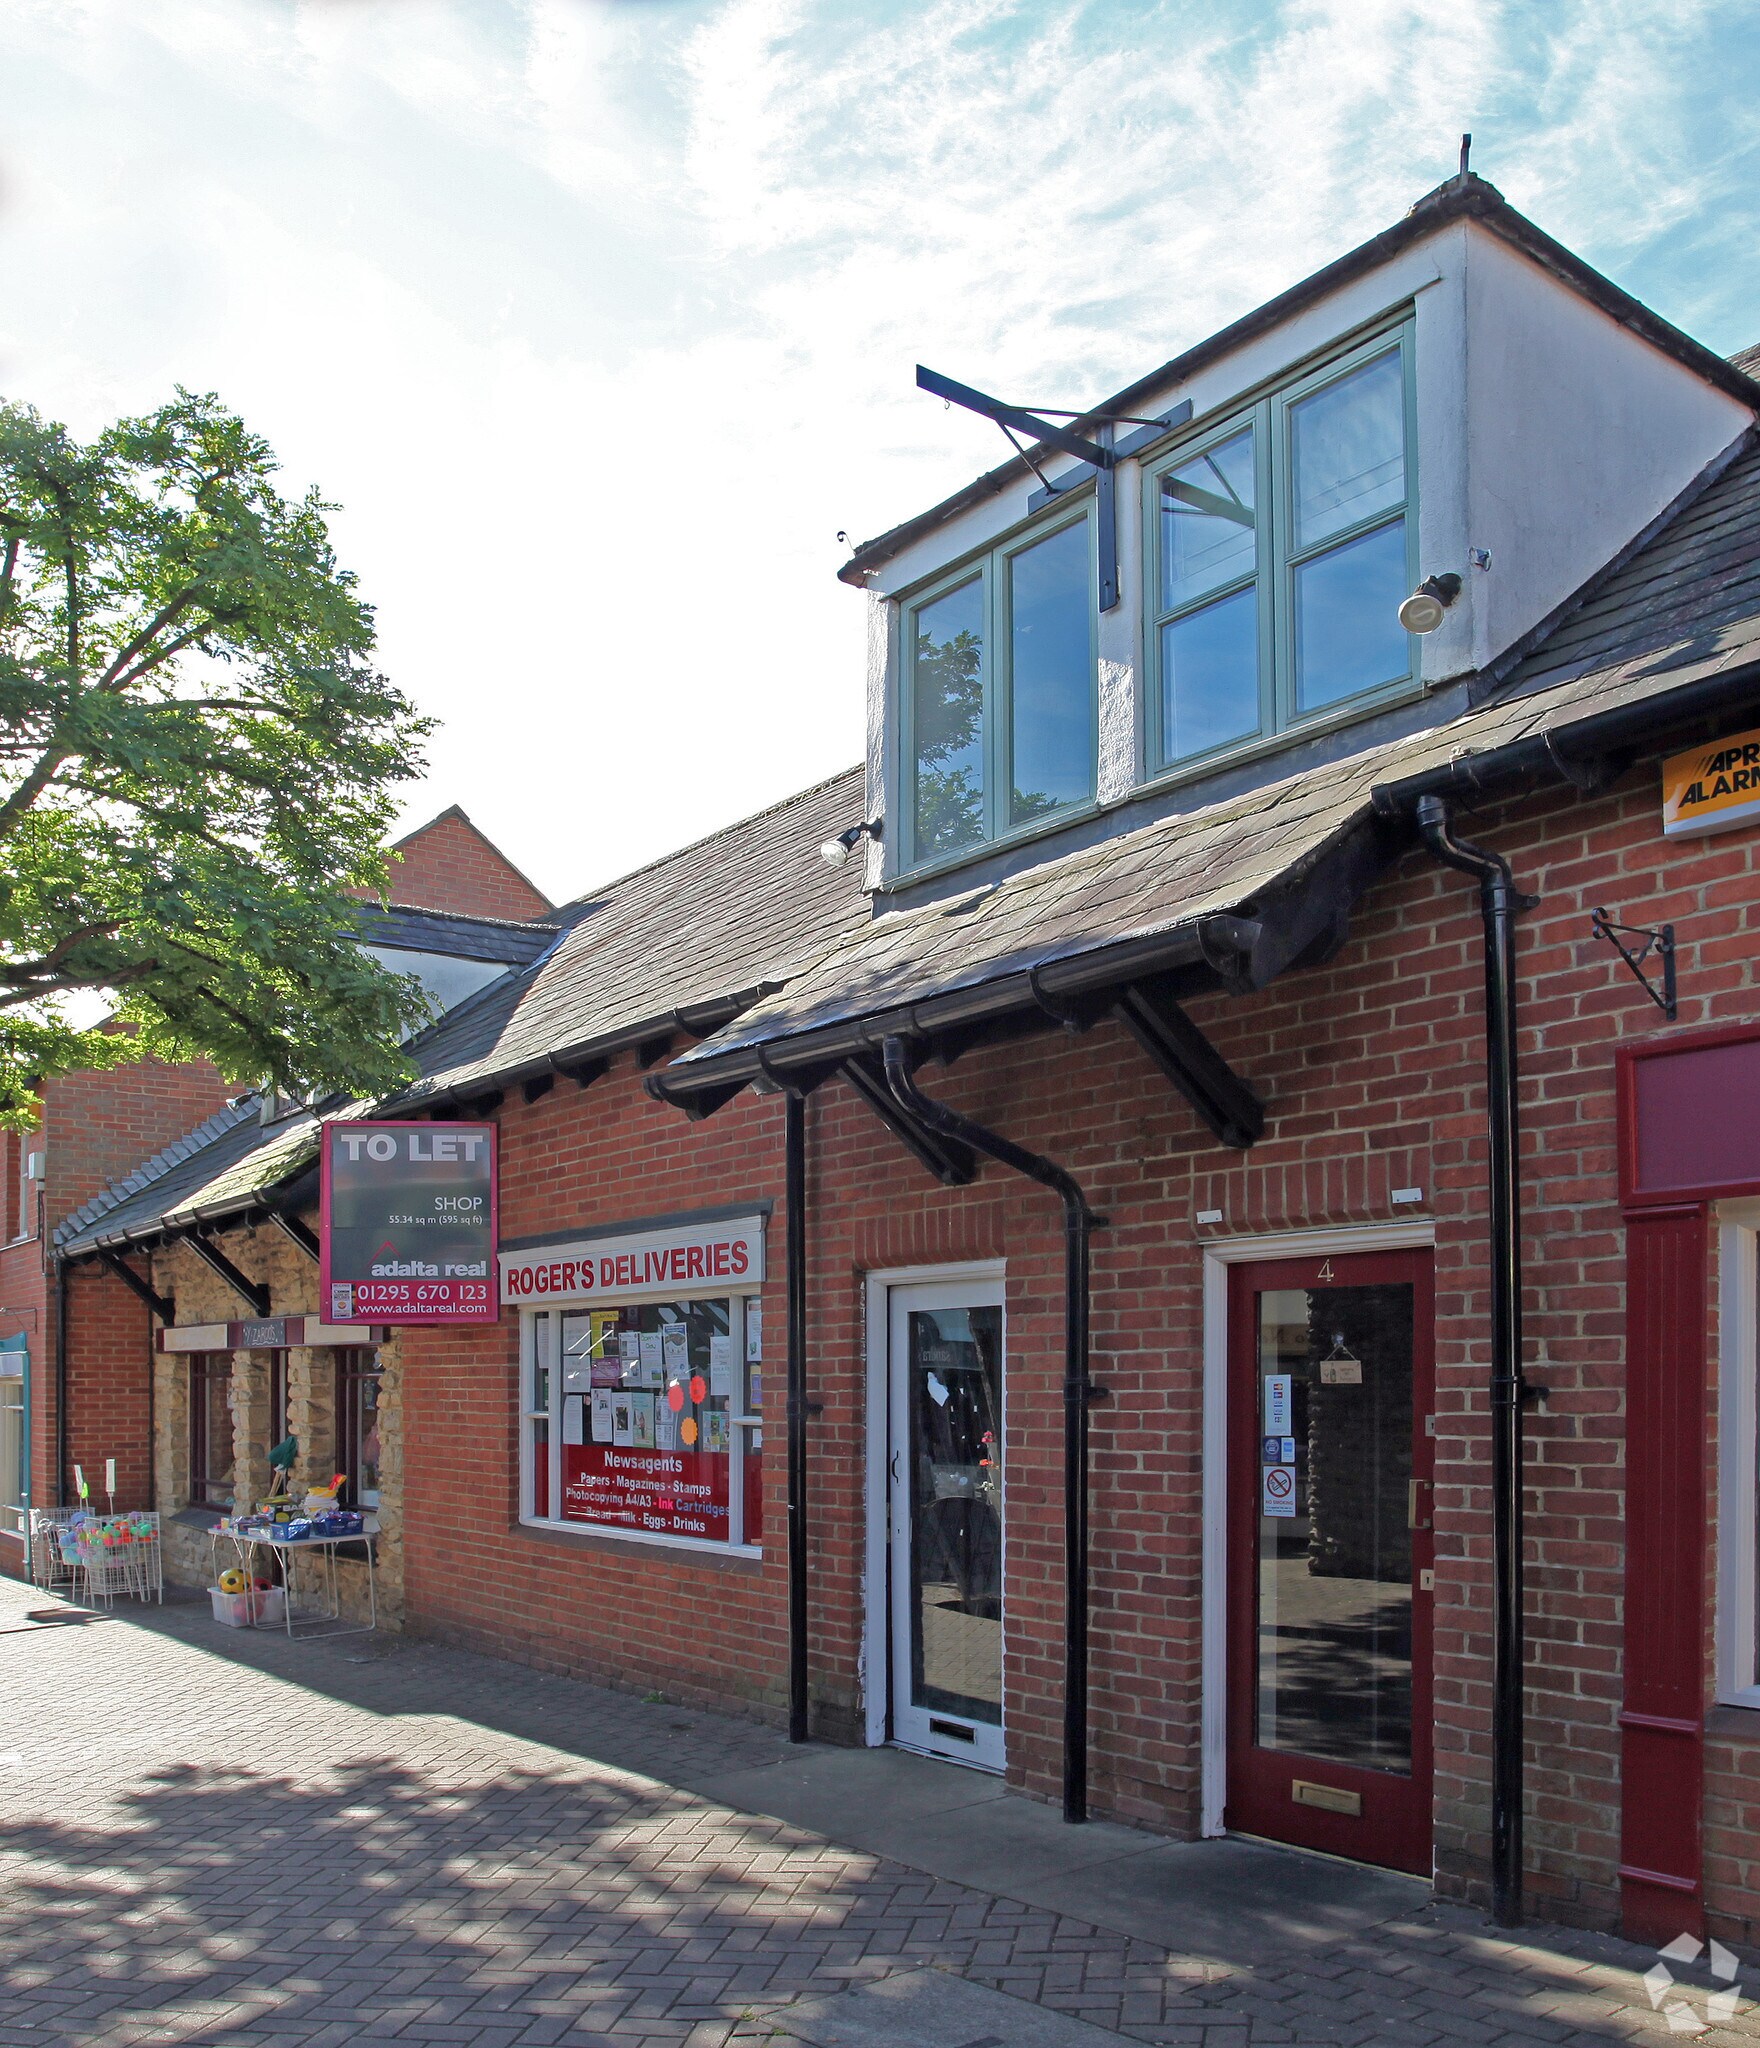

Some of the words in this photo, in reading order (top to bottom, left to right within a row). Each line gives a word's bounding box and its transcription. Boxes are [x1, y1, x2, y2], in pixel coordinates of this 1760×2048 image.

[341, 1134, 397, 1162] TO
[409, 1134, 483, 1162] LET
[434, 1197, 483, 1211] SHOP
[389, 1216, 413, 1224] 55.34
[415, 1217, 425, 1226] sq
[439, 1215, 458, 1226] (595
[460, 1217, 471, 1226] sq
[472, 1215, 483, 1226] ft)
[371, 1261, 438, 1277] adalta
[445, 1261, 487, 1277] real
[507, 1259, 595, 1295] ROGER'S
[600, 1240, 749, 1288] DELIVERIES
[1317, 1258, 1335, 1282] 4
[357, 1285, 410, 1300] 01295
[417, 1285, 450, 1300] 670
[459, 1285, 487, 1300] 123
[358, 1302, 487, 1314] www.adaltareal.com
[604, 1451, 683, 1474] Newsagents
[580, 1472, 610, 1486] Papers
[616, 1475, 666, 1491] Magazines
[673, 1480, 711, 1497] Stamps
[566, 1487, 623, 1506] Photocopying
[625, 1493, 652, 1508] A4/A3
[658, 1496, 674, 1510] Ink
[676, 1498, 730, 1518] Cartridges
[643, 1512, 666, 1529] Eggs
[673, 1516, 706, 1532] Drinks
